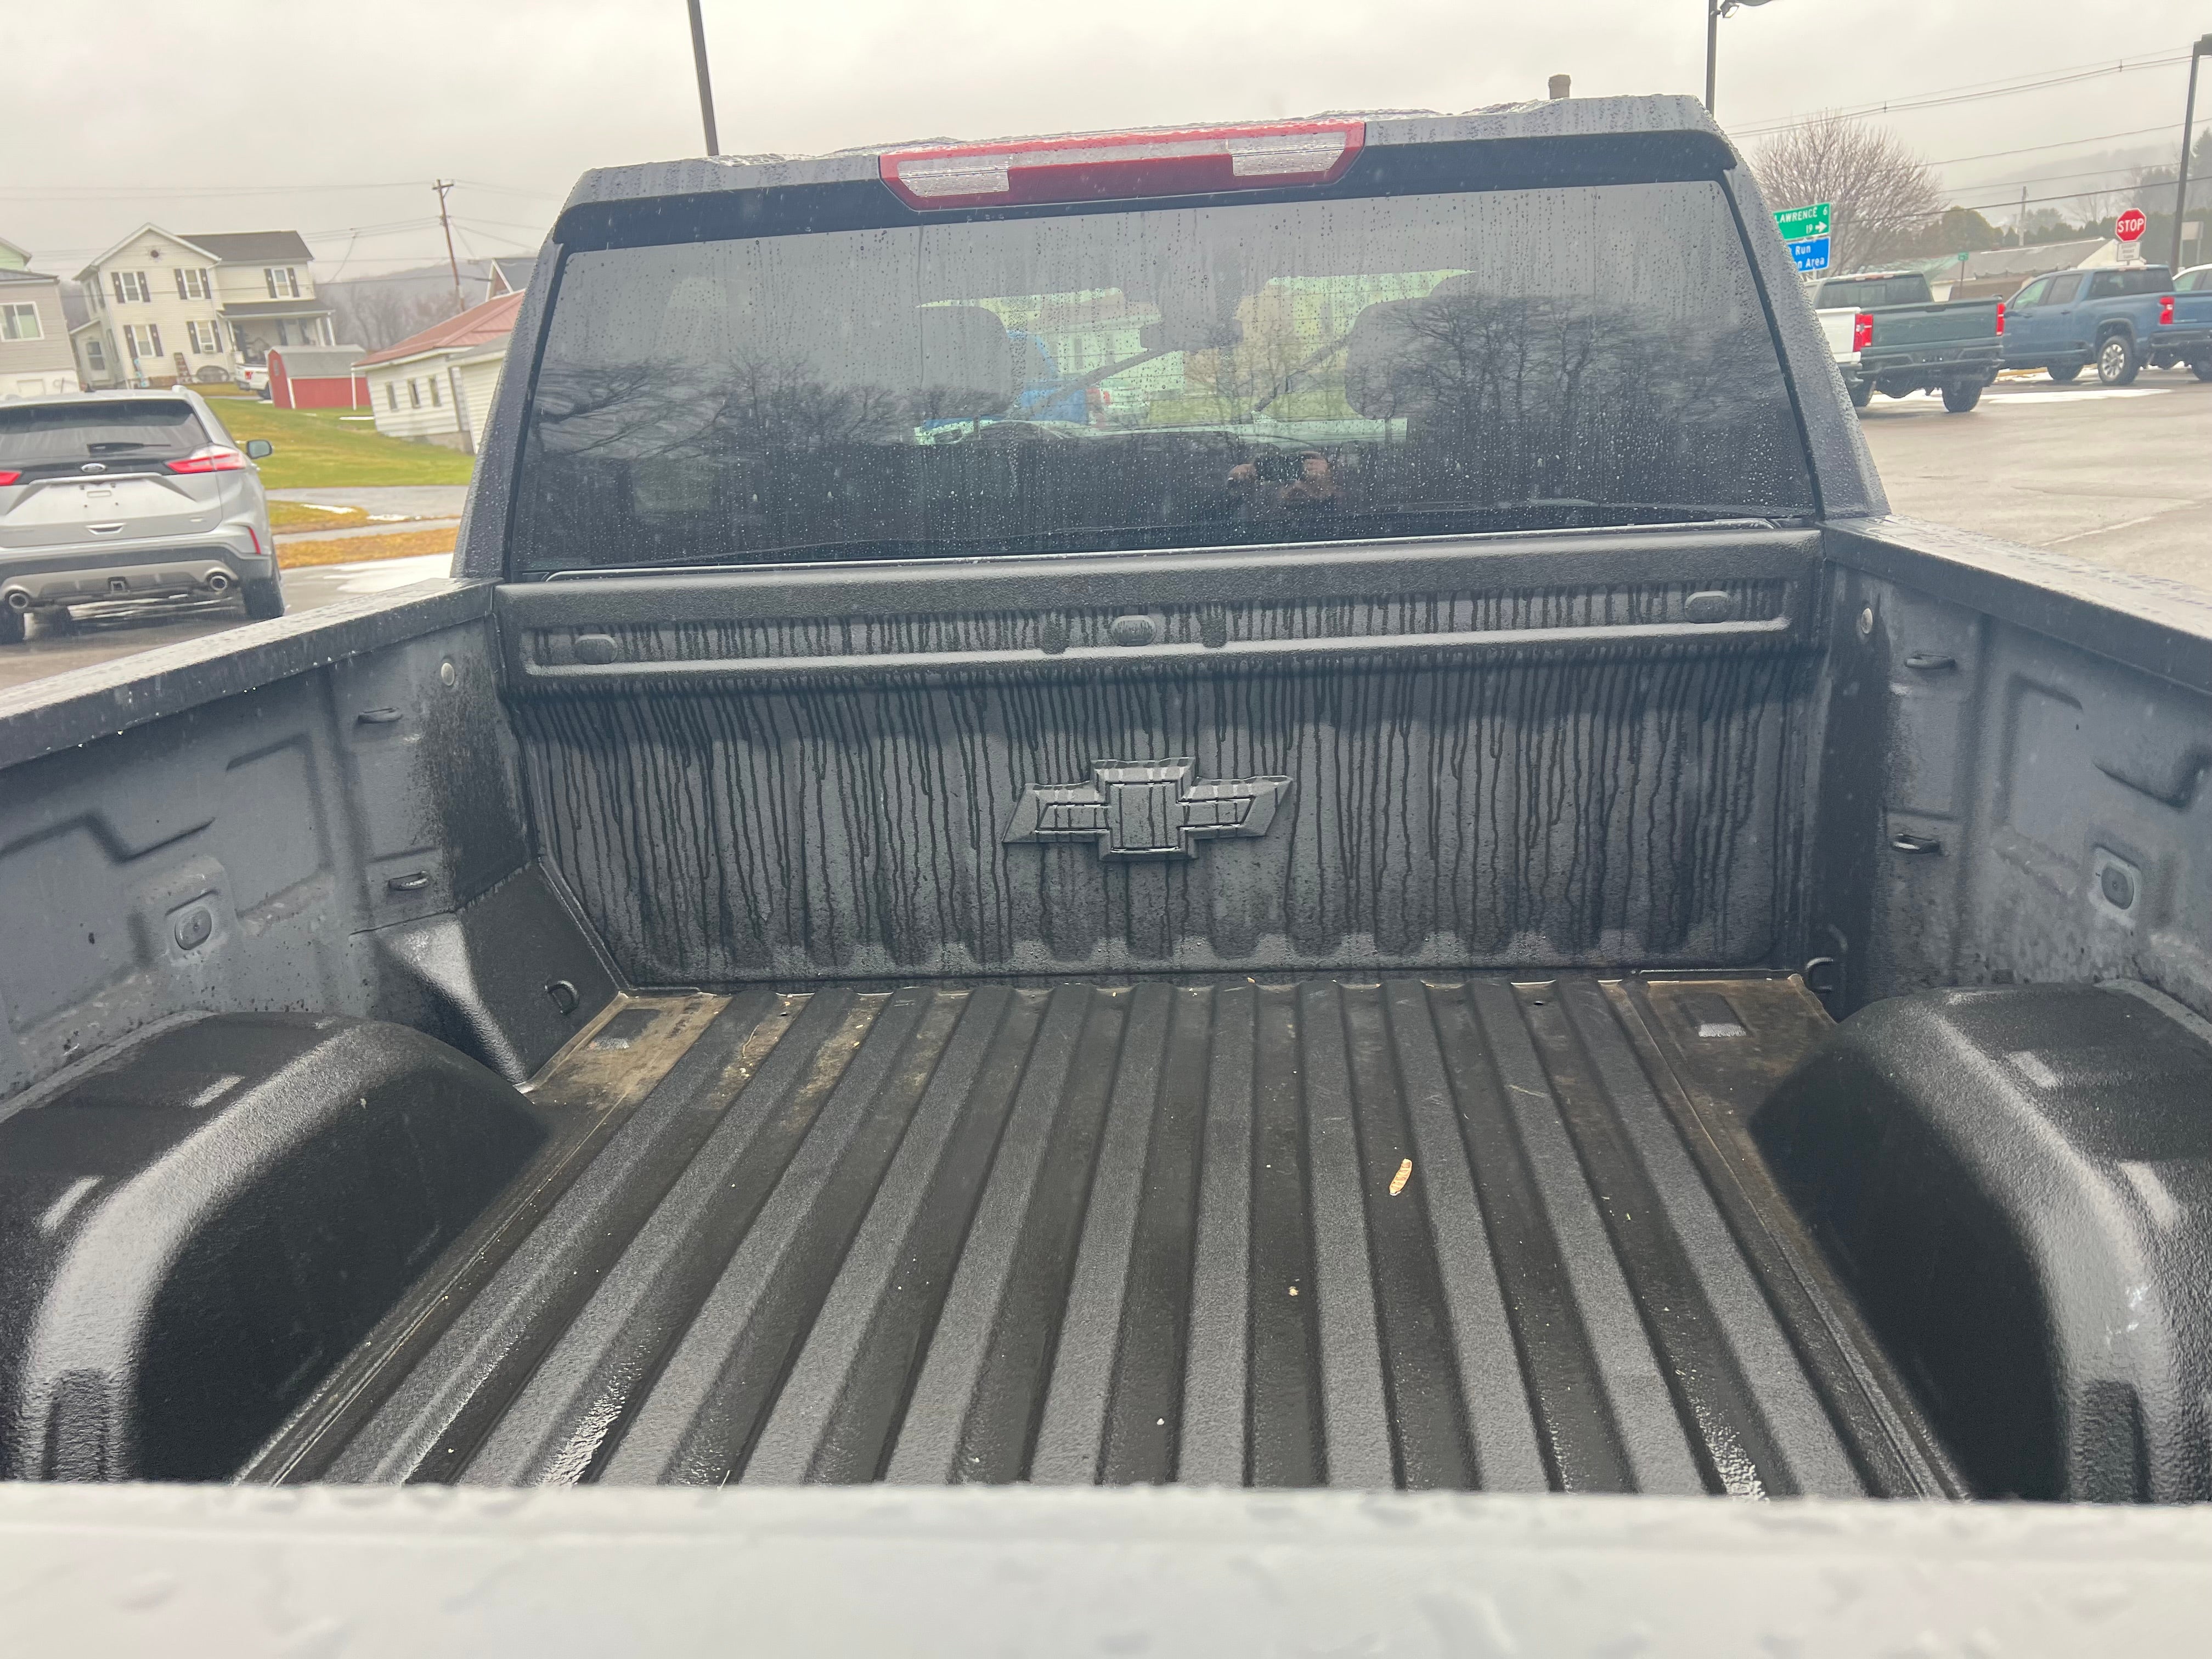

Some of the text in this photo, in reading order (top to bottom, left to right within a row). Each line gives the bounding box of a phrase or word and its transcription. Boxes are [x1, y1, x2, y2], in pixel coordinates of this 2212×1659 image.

[1774, 206, 1827, 223] LAWRENCE 6
[1806, 224, 1813, 234] 19
[2118, 218, 2144, 233] STOP
[1795, 245, 1811, 256] Run
[1805, 257, 1825, 268] Area
